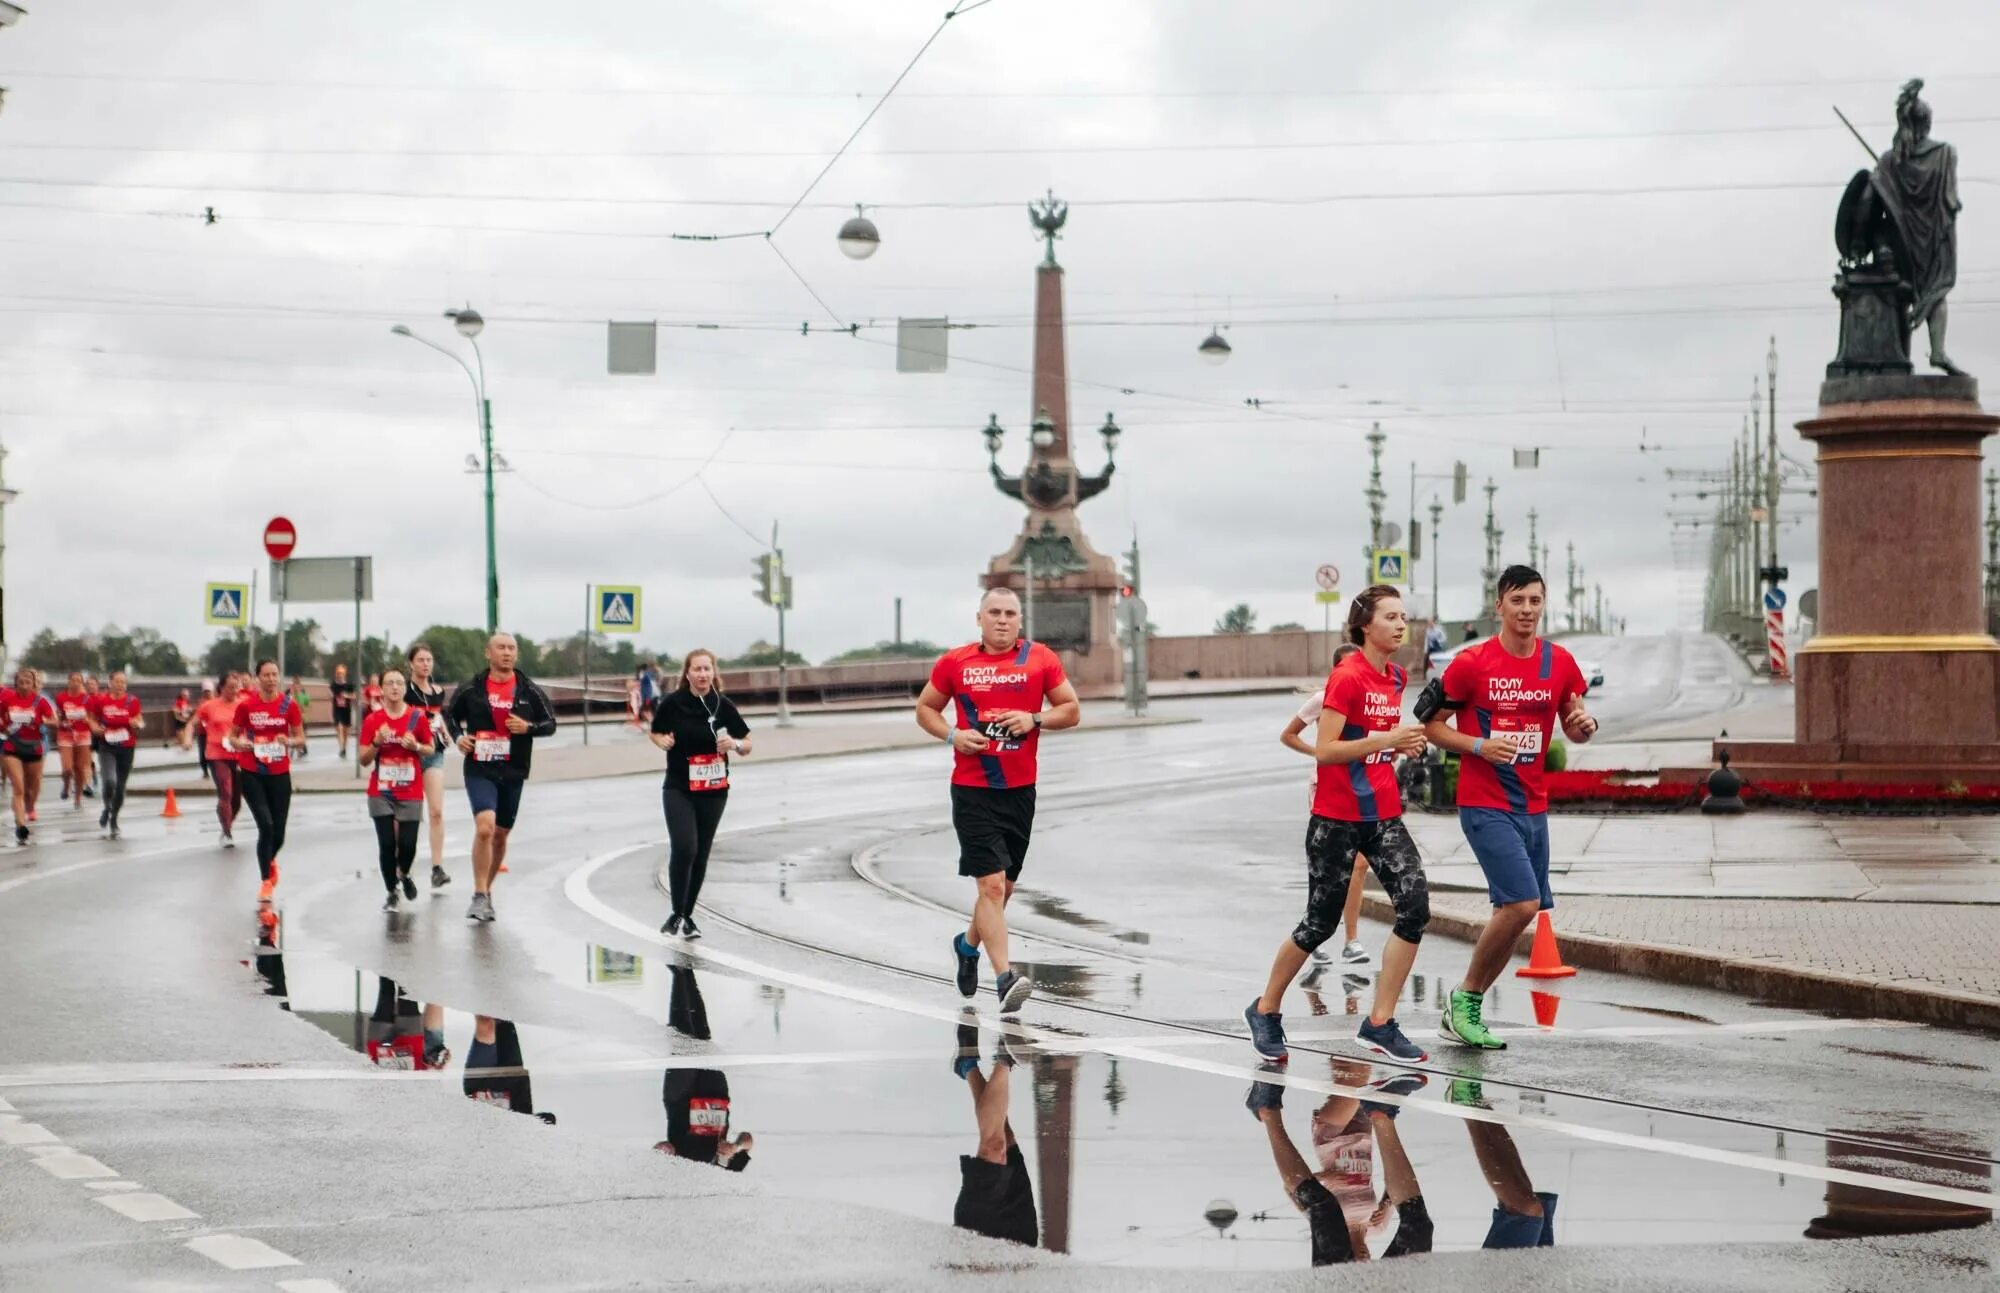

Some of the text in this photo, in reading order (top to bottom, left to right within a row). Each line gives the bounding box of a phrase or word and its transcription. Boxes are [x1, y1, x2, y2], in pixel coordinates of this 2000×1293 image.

[963, 666, 998, 676] ПОЛУ
[963, 673, 1027, 685] МАРАФОН
[1489, 677, 1523, 689] ПОЛУ
[1489, 689, 1552, 701] МАРАФОН
[1364, 705, 1400, 717] МАРАФО
[696, 764, 720, 776] 4710
